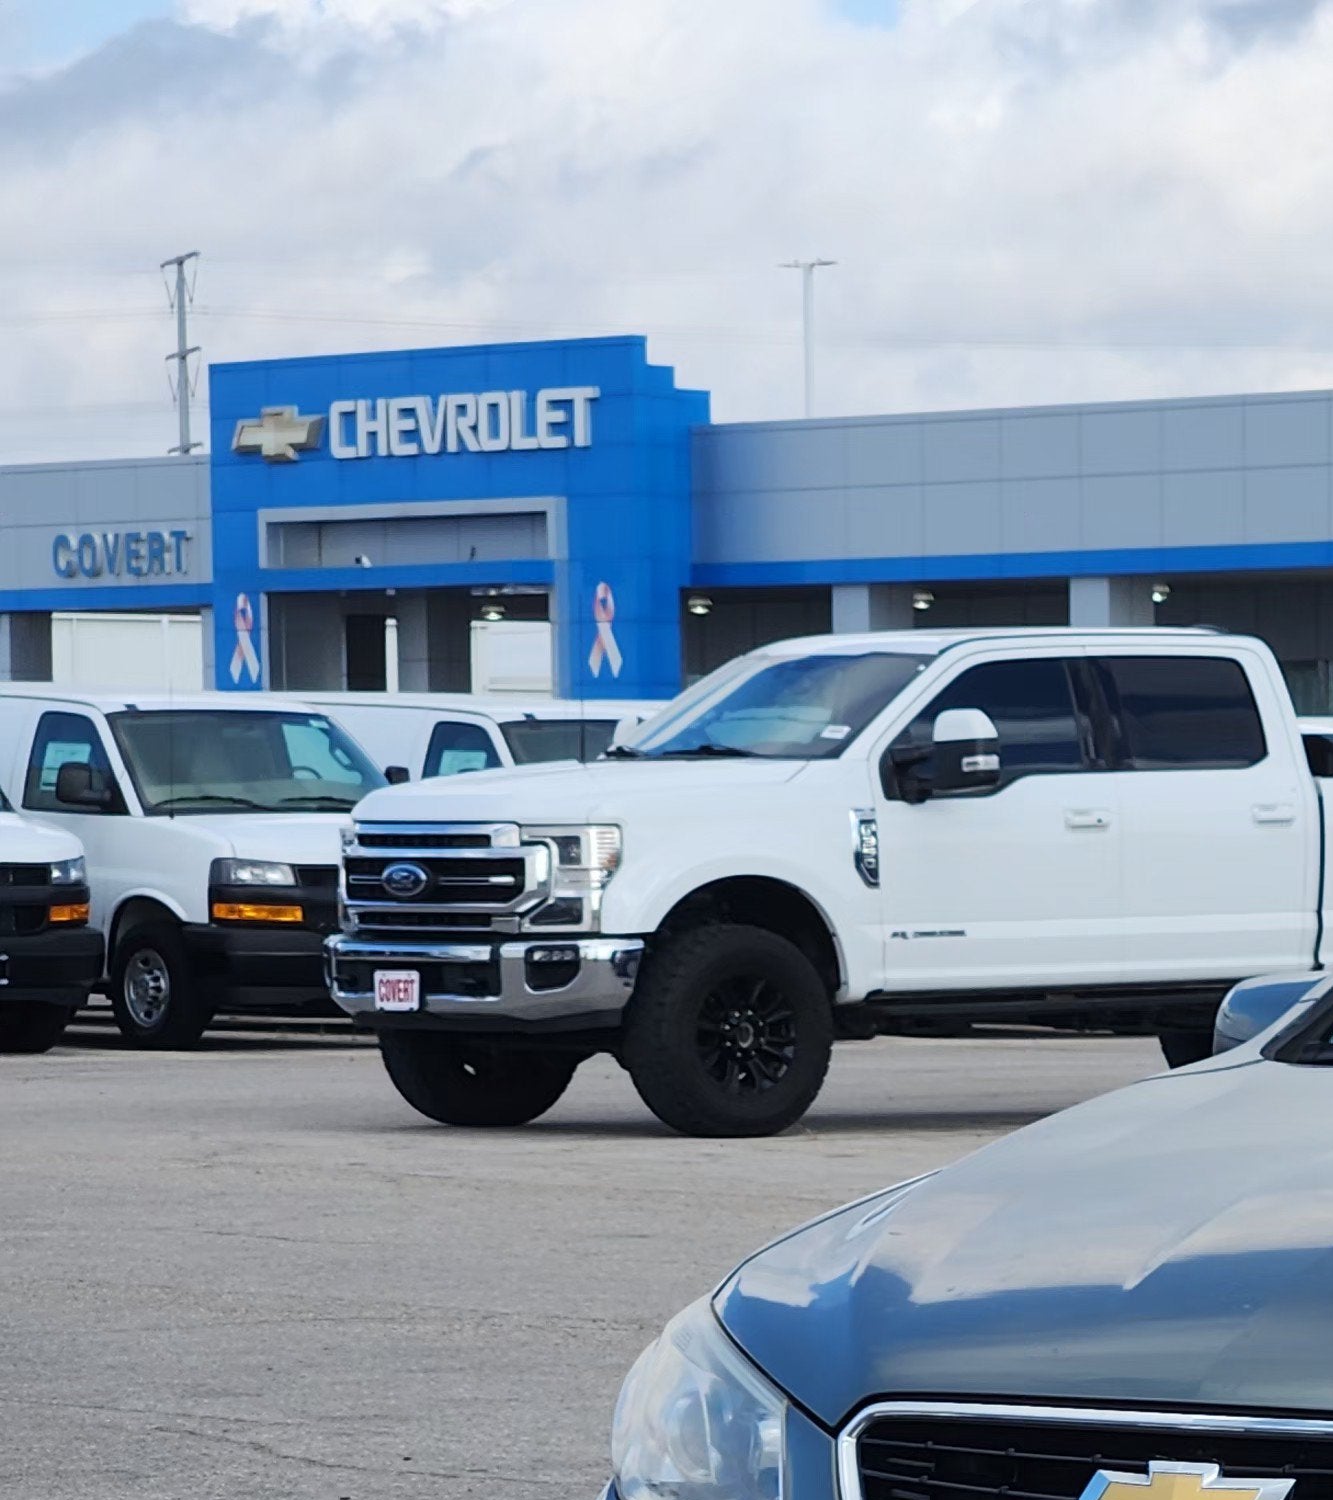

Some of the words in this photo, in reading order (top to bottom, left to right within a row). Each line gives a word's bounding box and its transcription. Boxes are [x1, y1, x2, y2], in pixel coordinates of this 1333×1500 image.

[329, 387, 600, 459] CHEVROLET
[52, 530, 189, 578] COVERT
[379, 979, 415, 1002] COVERT
